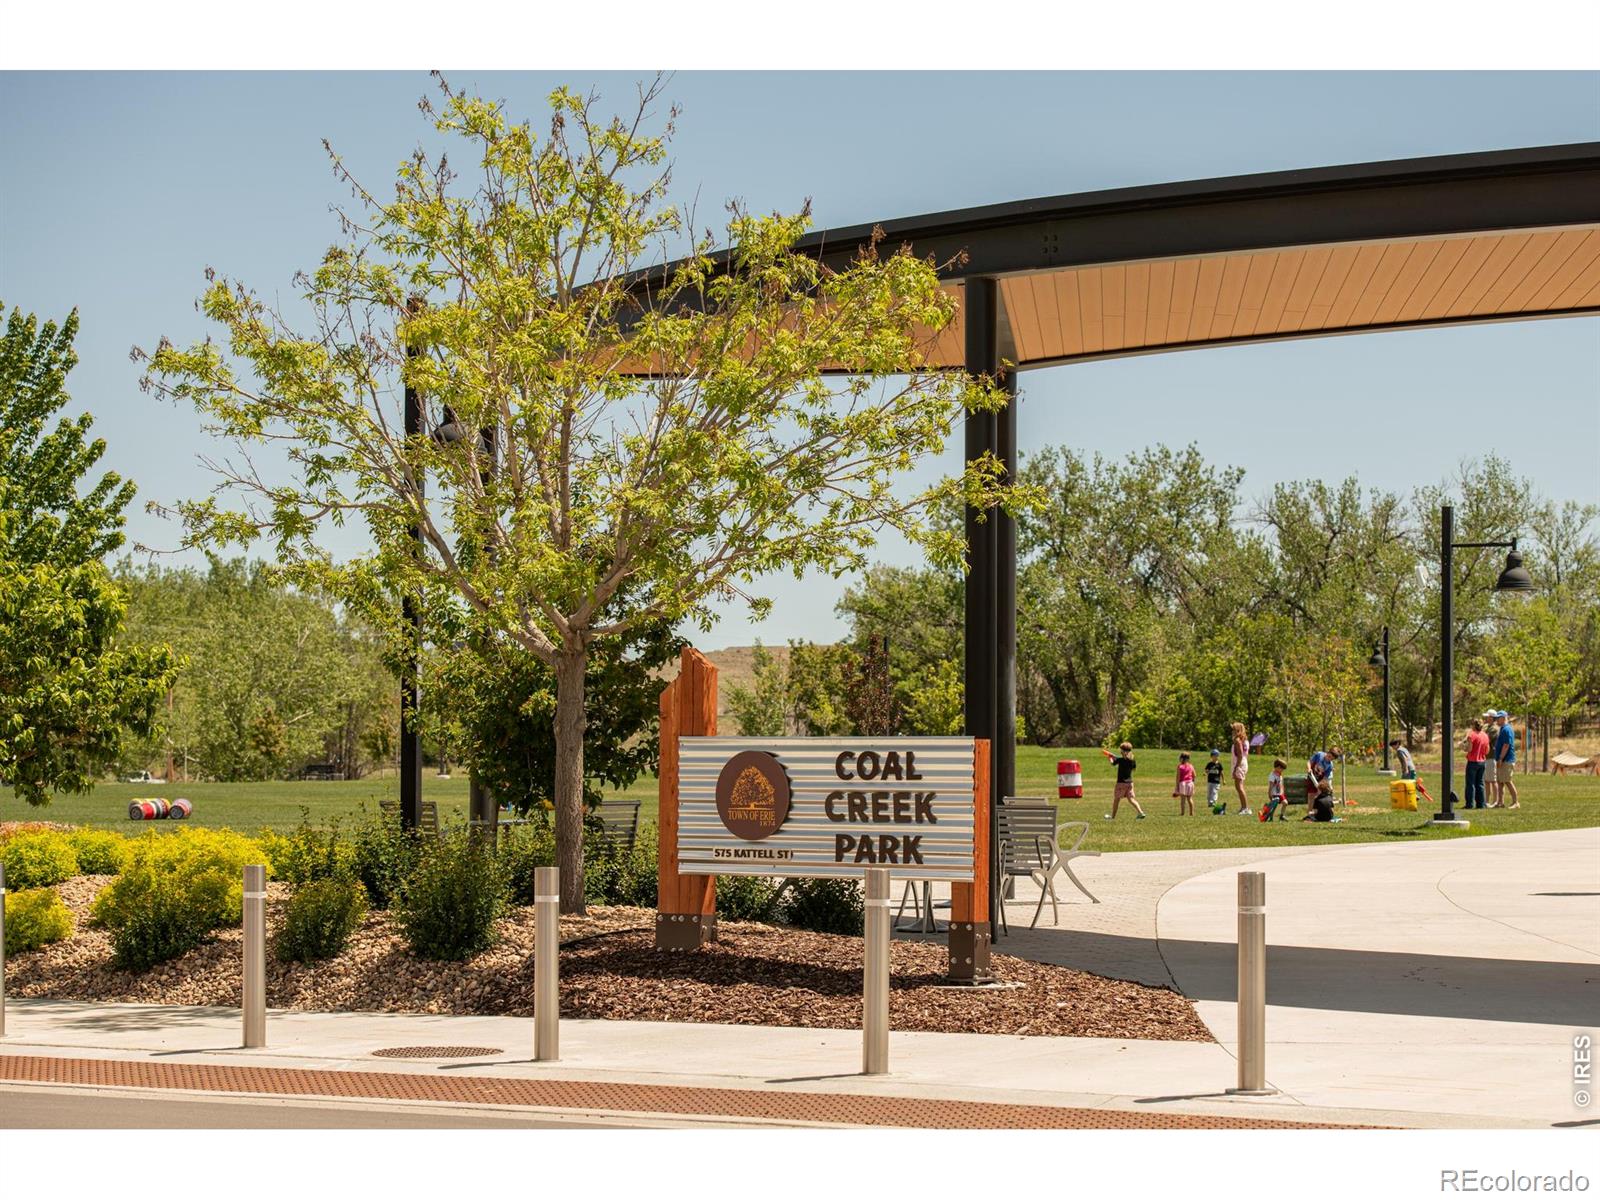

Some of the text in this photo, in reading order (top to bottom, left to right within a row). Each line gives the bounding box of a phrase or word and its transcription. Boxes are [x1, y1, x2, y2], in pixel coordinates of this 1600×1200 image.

[835, 750, 922, 781] COAL
[728, 811, 776, 821] TOWN OF ERIE
[824, 791, 937, 824] CREEK
[714, 848, 732, 858] 575
[734, 849, 774, 859] KATTELL
[835, 834, 923, 864] PARK
